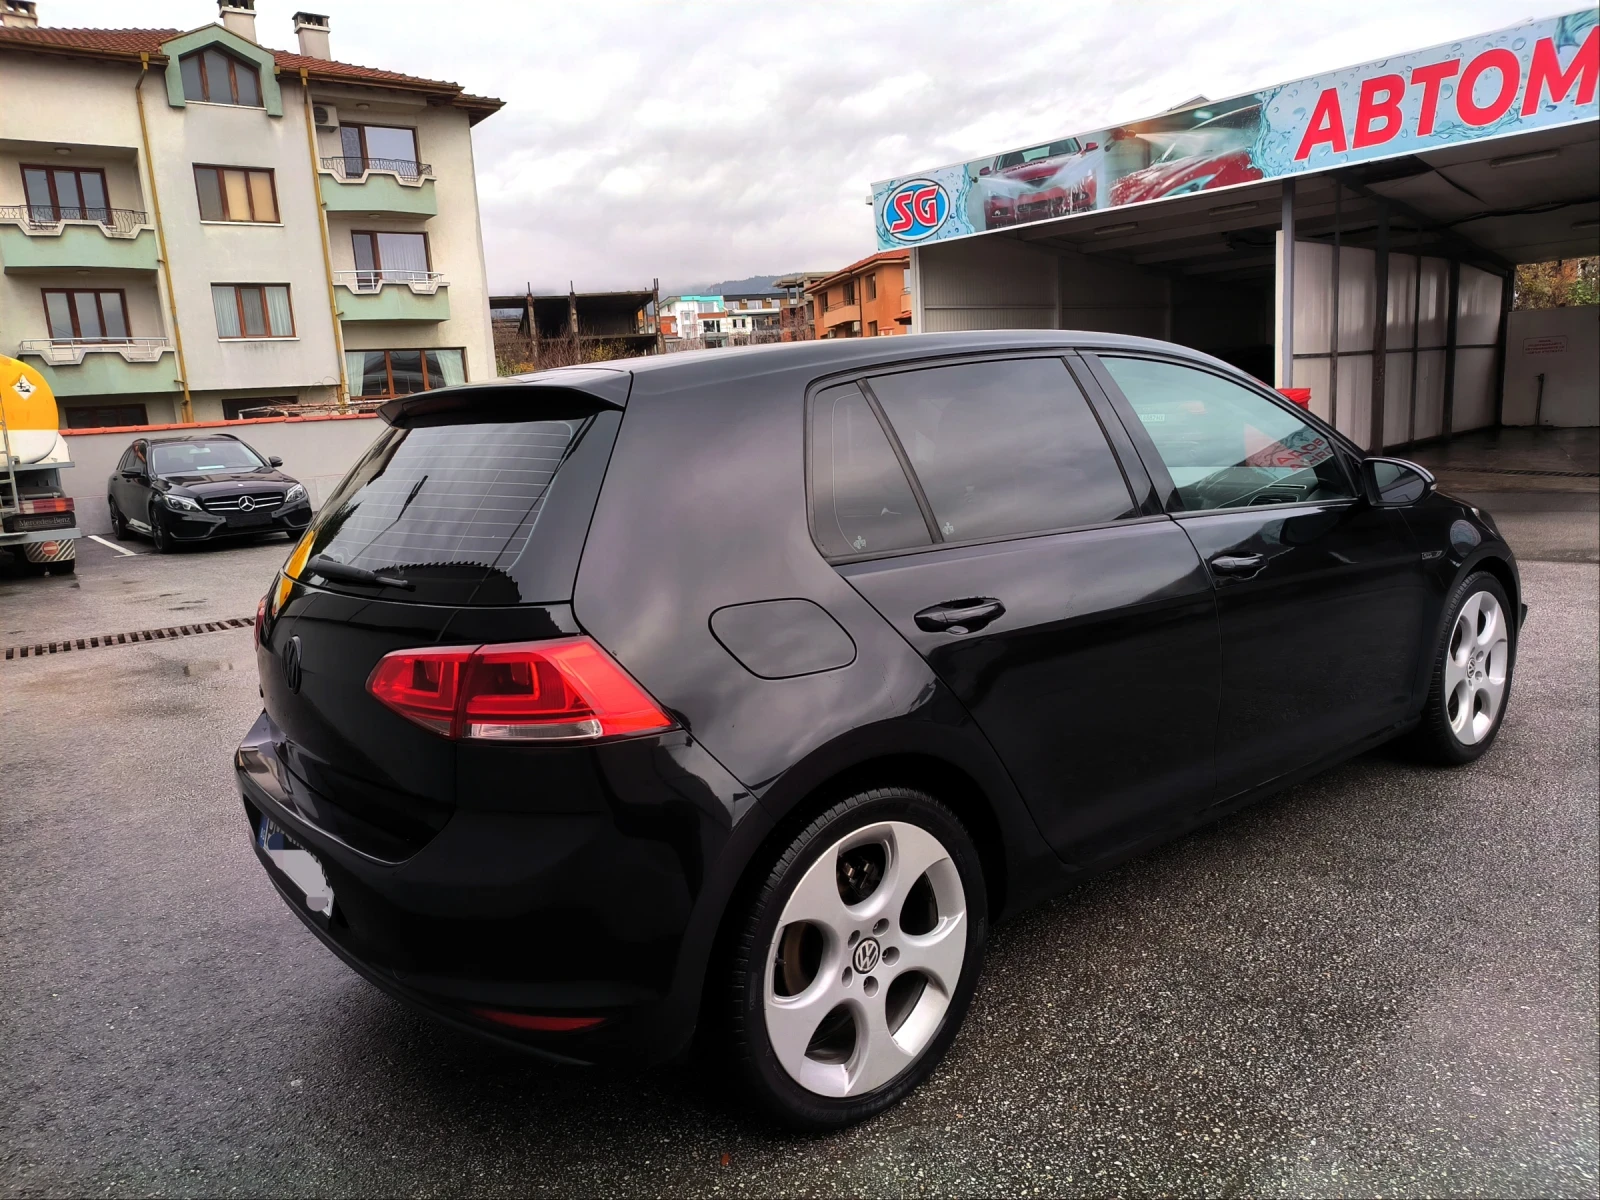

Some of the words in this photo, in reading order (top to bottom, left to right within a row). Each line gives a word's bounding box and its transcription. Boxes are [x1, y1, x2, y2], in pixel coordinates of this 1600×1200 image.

[1294, 25, 1599, 161] АВТОМ
[889, 184, 939, 233] SG
[18, 516, 71, 527] Mercedes-Benz
[854, 938, 880, 973] VW
